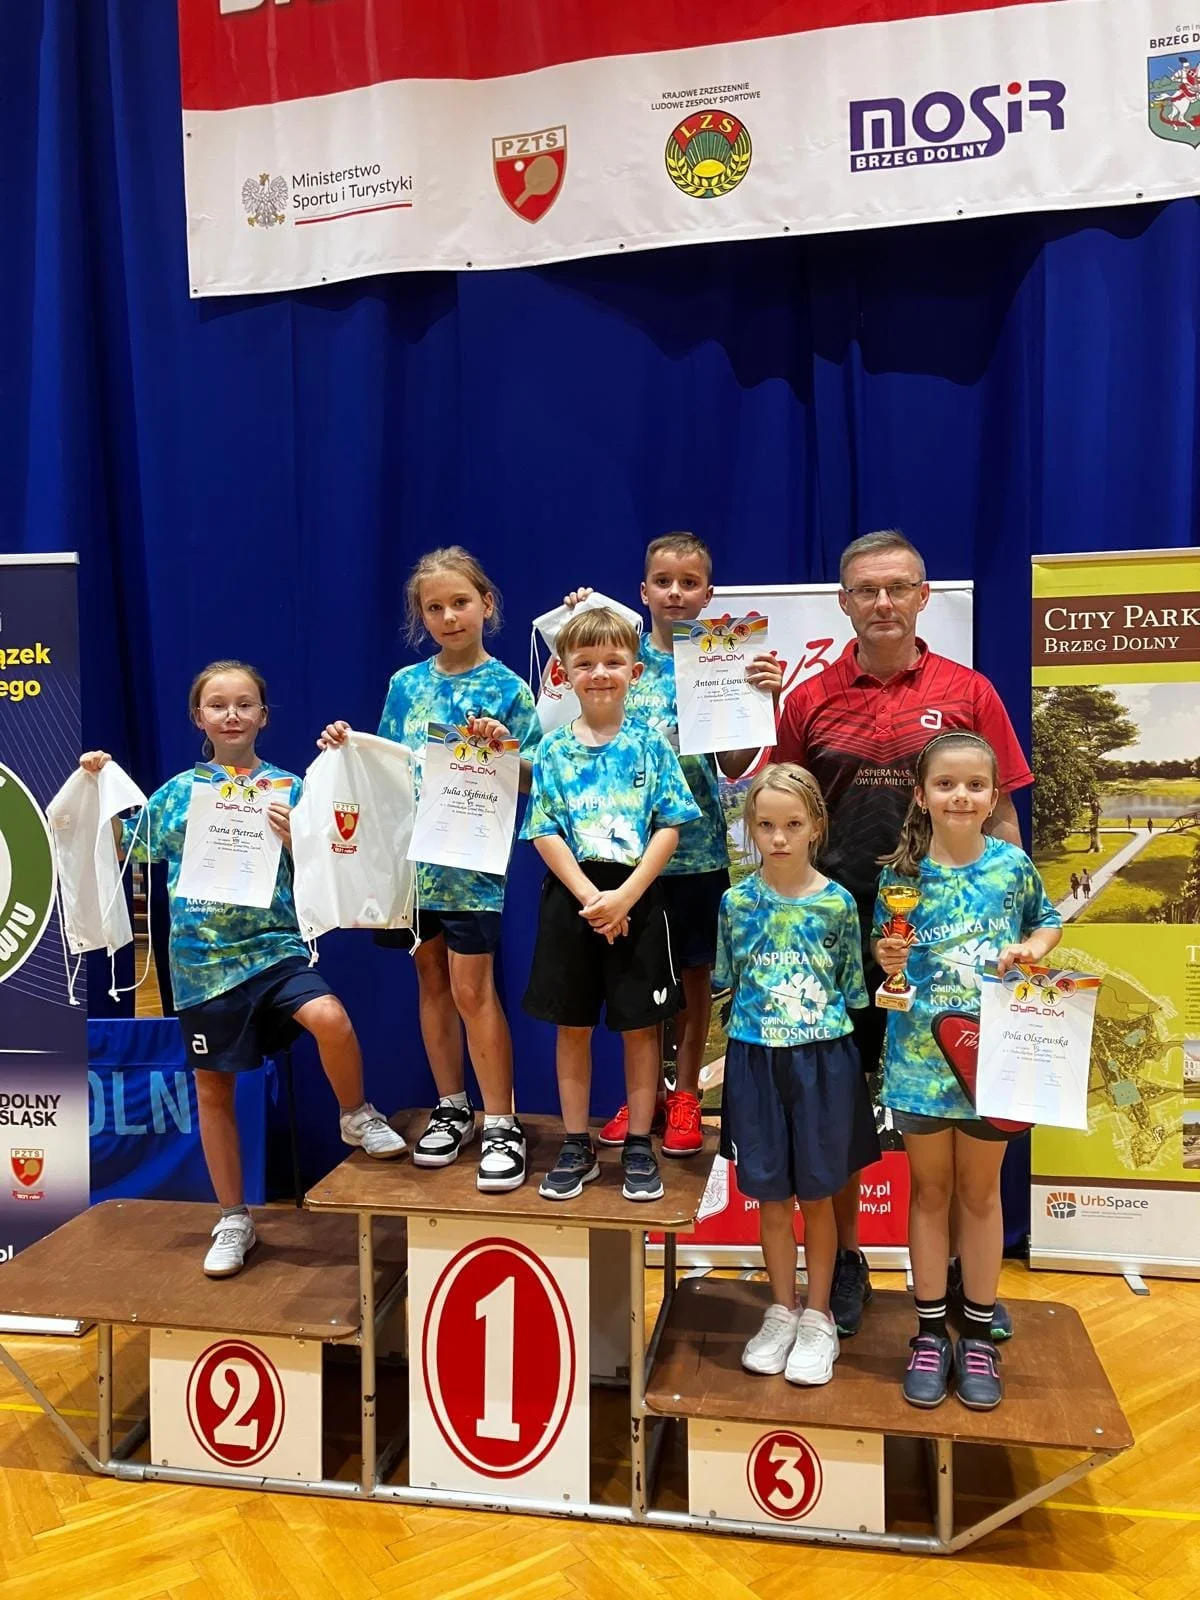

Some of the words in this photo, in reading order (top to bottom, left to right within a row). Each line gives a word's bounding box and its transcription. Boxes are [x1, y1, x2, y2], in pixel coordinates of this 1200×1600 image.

[1149, 34, 1189, 49] BRZEG
[662, 88, 698, 100] KRAJOWE
[699, 82, 750, 96] ZRZESZENNIE
[651, 100, 684, 111] LUDOWE
[685, 96, 718, 108] ZESPOŁY
[719, 91, 761, 104] SPORTOWE
[680, 114, 735, 139] LZS
[501, 132, 558, 156] PZTS
[855, 151, 918, 170] BRZEG
[923, 142, 989, 163] DOLNY
[292, 164, 381, 189] Ministerstwo
[293, 191, 338, 211] Sportu
[342, 187, 346, 201] i
[349, 175, 413, 199] Turystyki
[698, 653, 745, 663] DYPLOM
[450, 762, 497, 776] DYPLOM
[215, 802, 262, 814] DYPLOM
[1010, 1004, 1065, 1018] DYPLOM
[0, 1093, 61, 1109] DOLNY
[15, 1150, 40, 1158] PZTS
[1081, 1194, 1149, 1210] UrbSpace
[474, 1276, 520, 1443] 1
[208, 1365, 259, 1450] 2
[767, 1443, 807, 1510] 3
